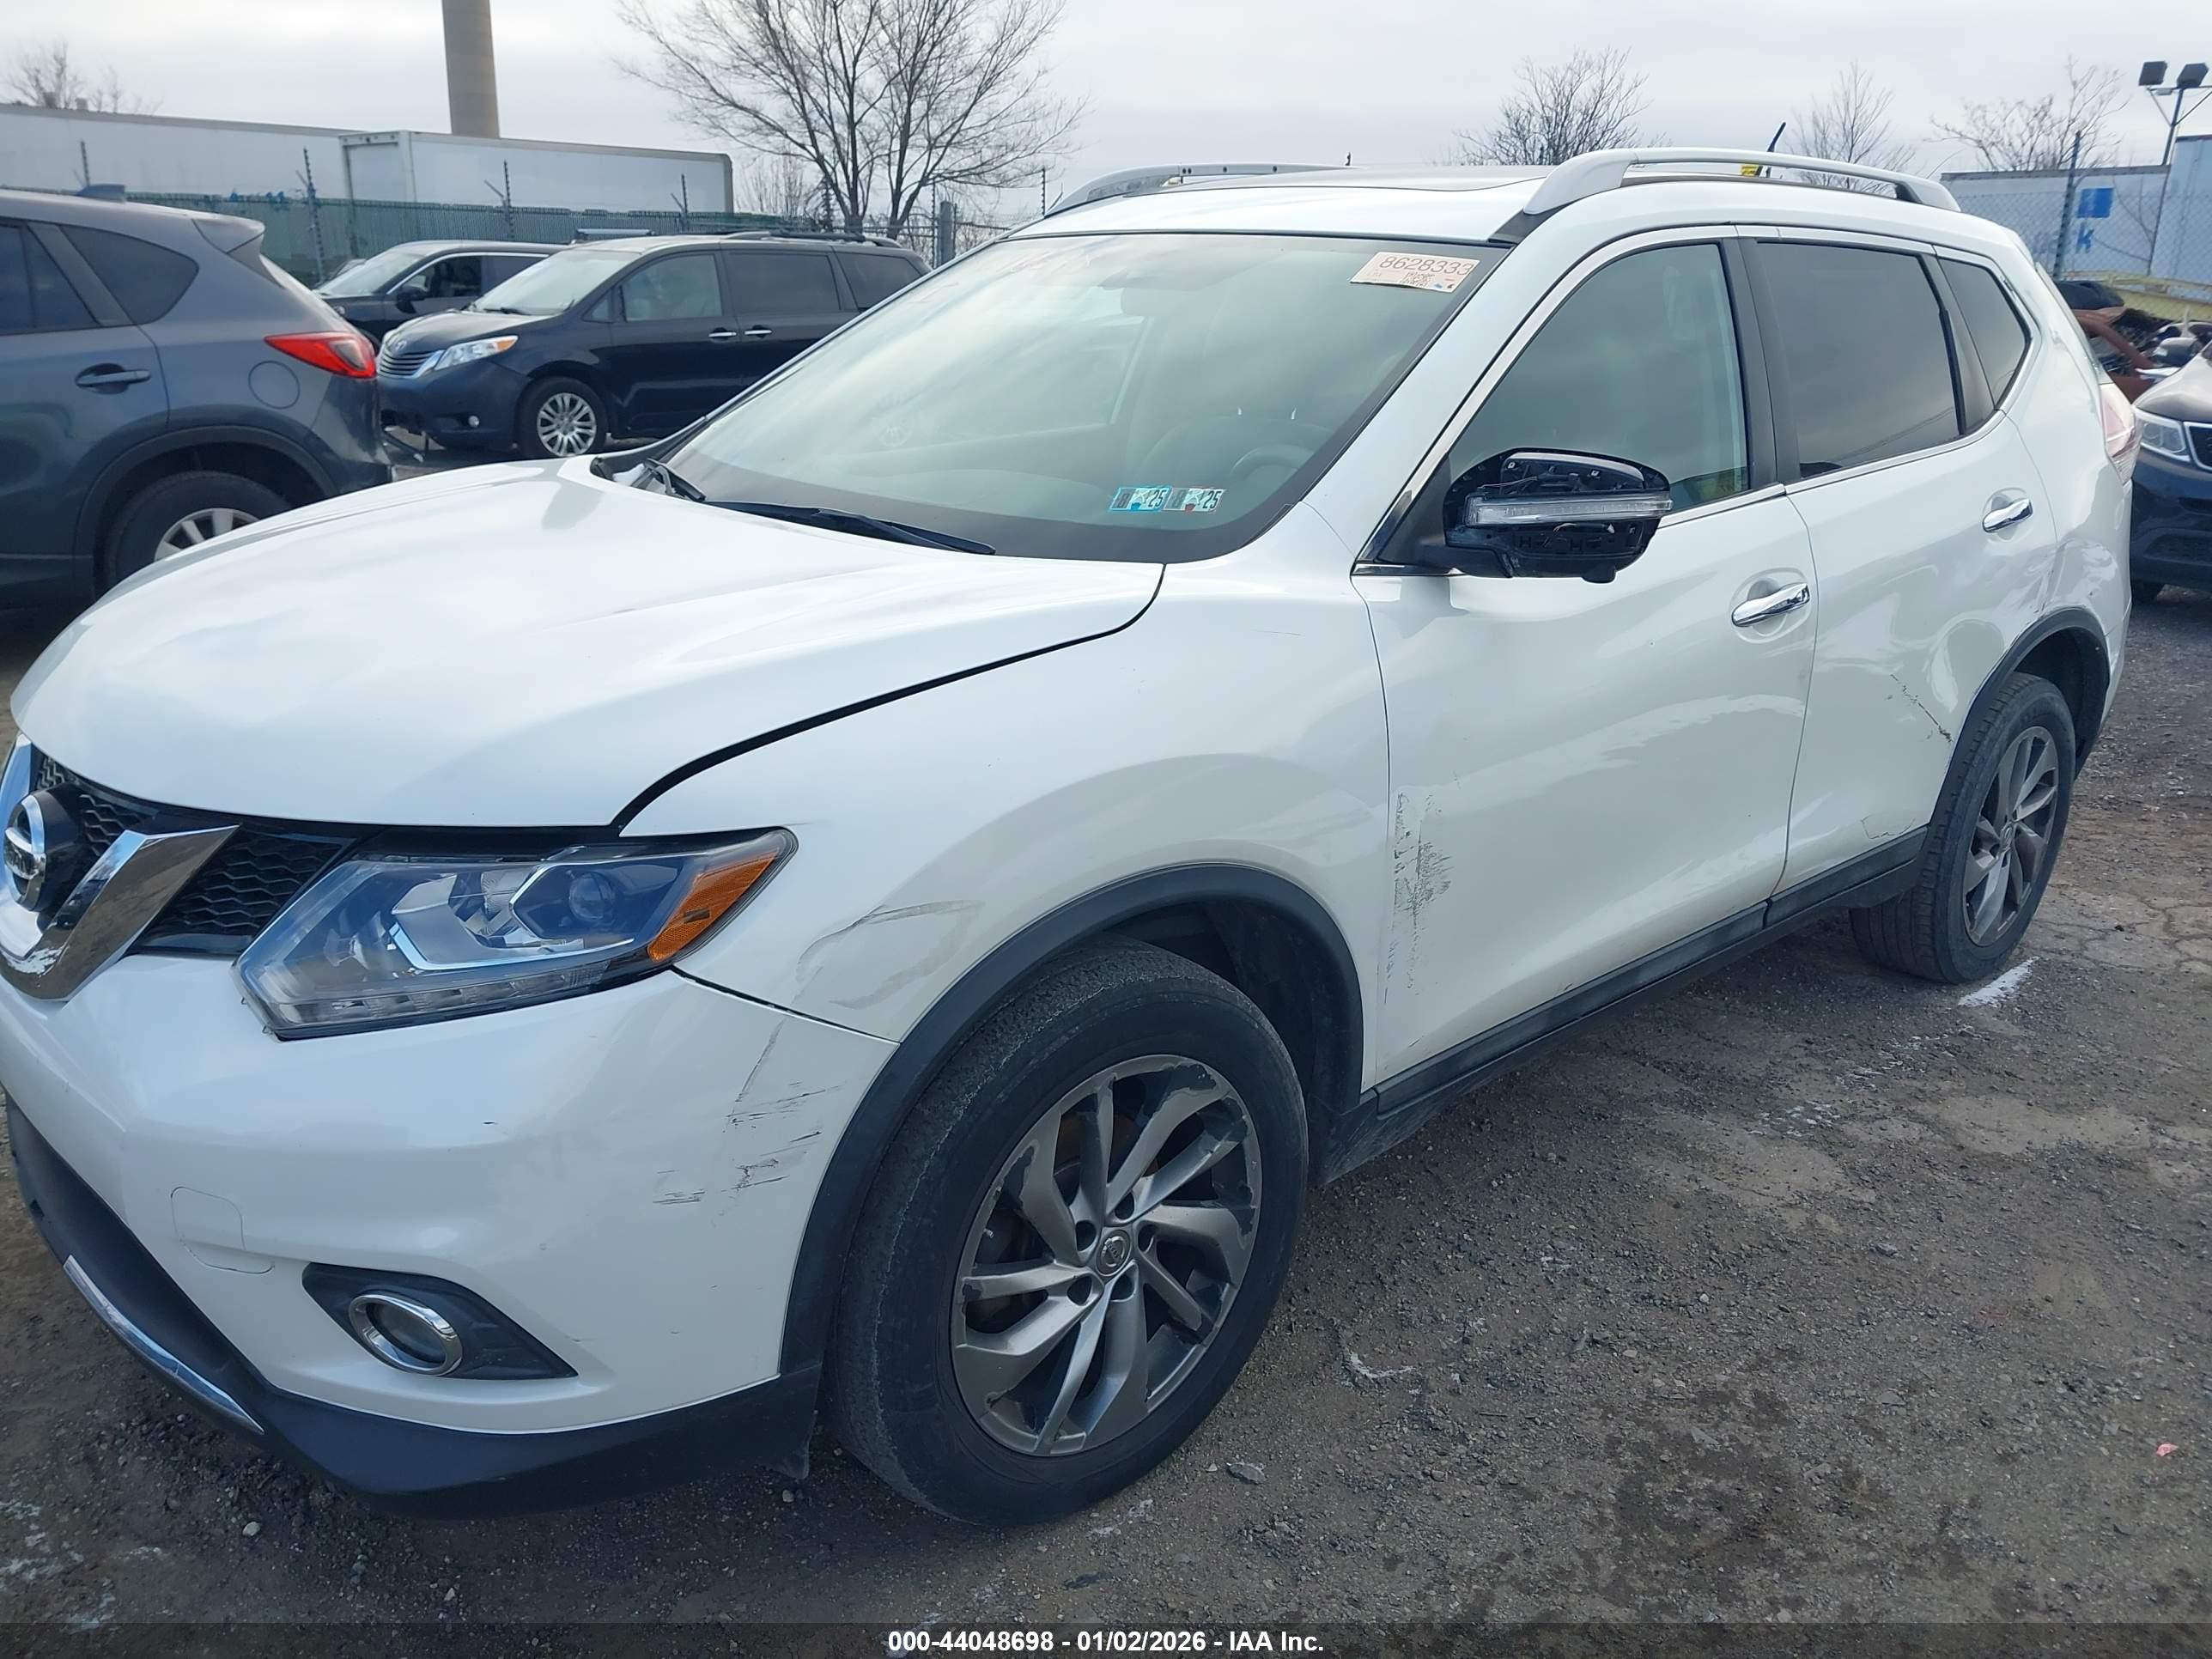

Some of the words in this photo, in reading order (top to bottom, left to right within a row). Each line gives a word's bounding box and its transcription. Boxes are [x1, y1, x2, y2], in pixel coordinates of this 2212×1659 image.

[1379, 256, 1474, 276] 8628333
[1148, 489, 1167, 507] 25
[1203, 490, 1222, 509] 25
